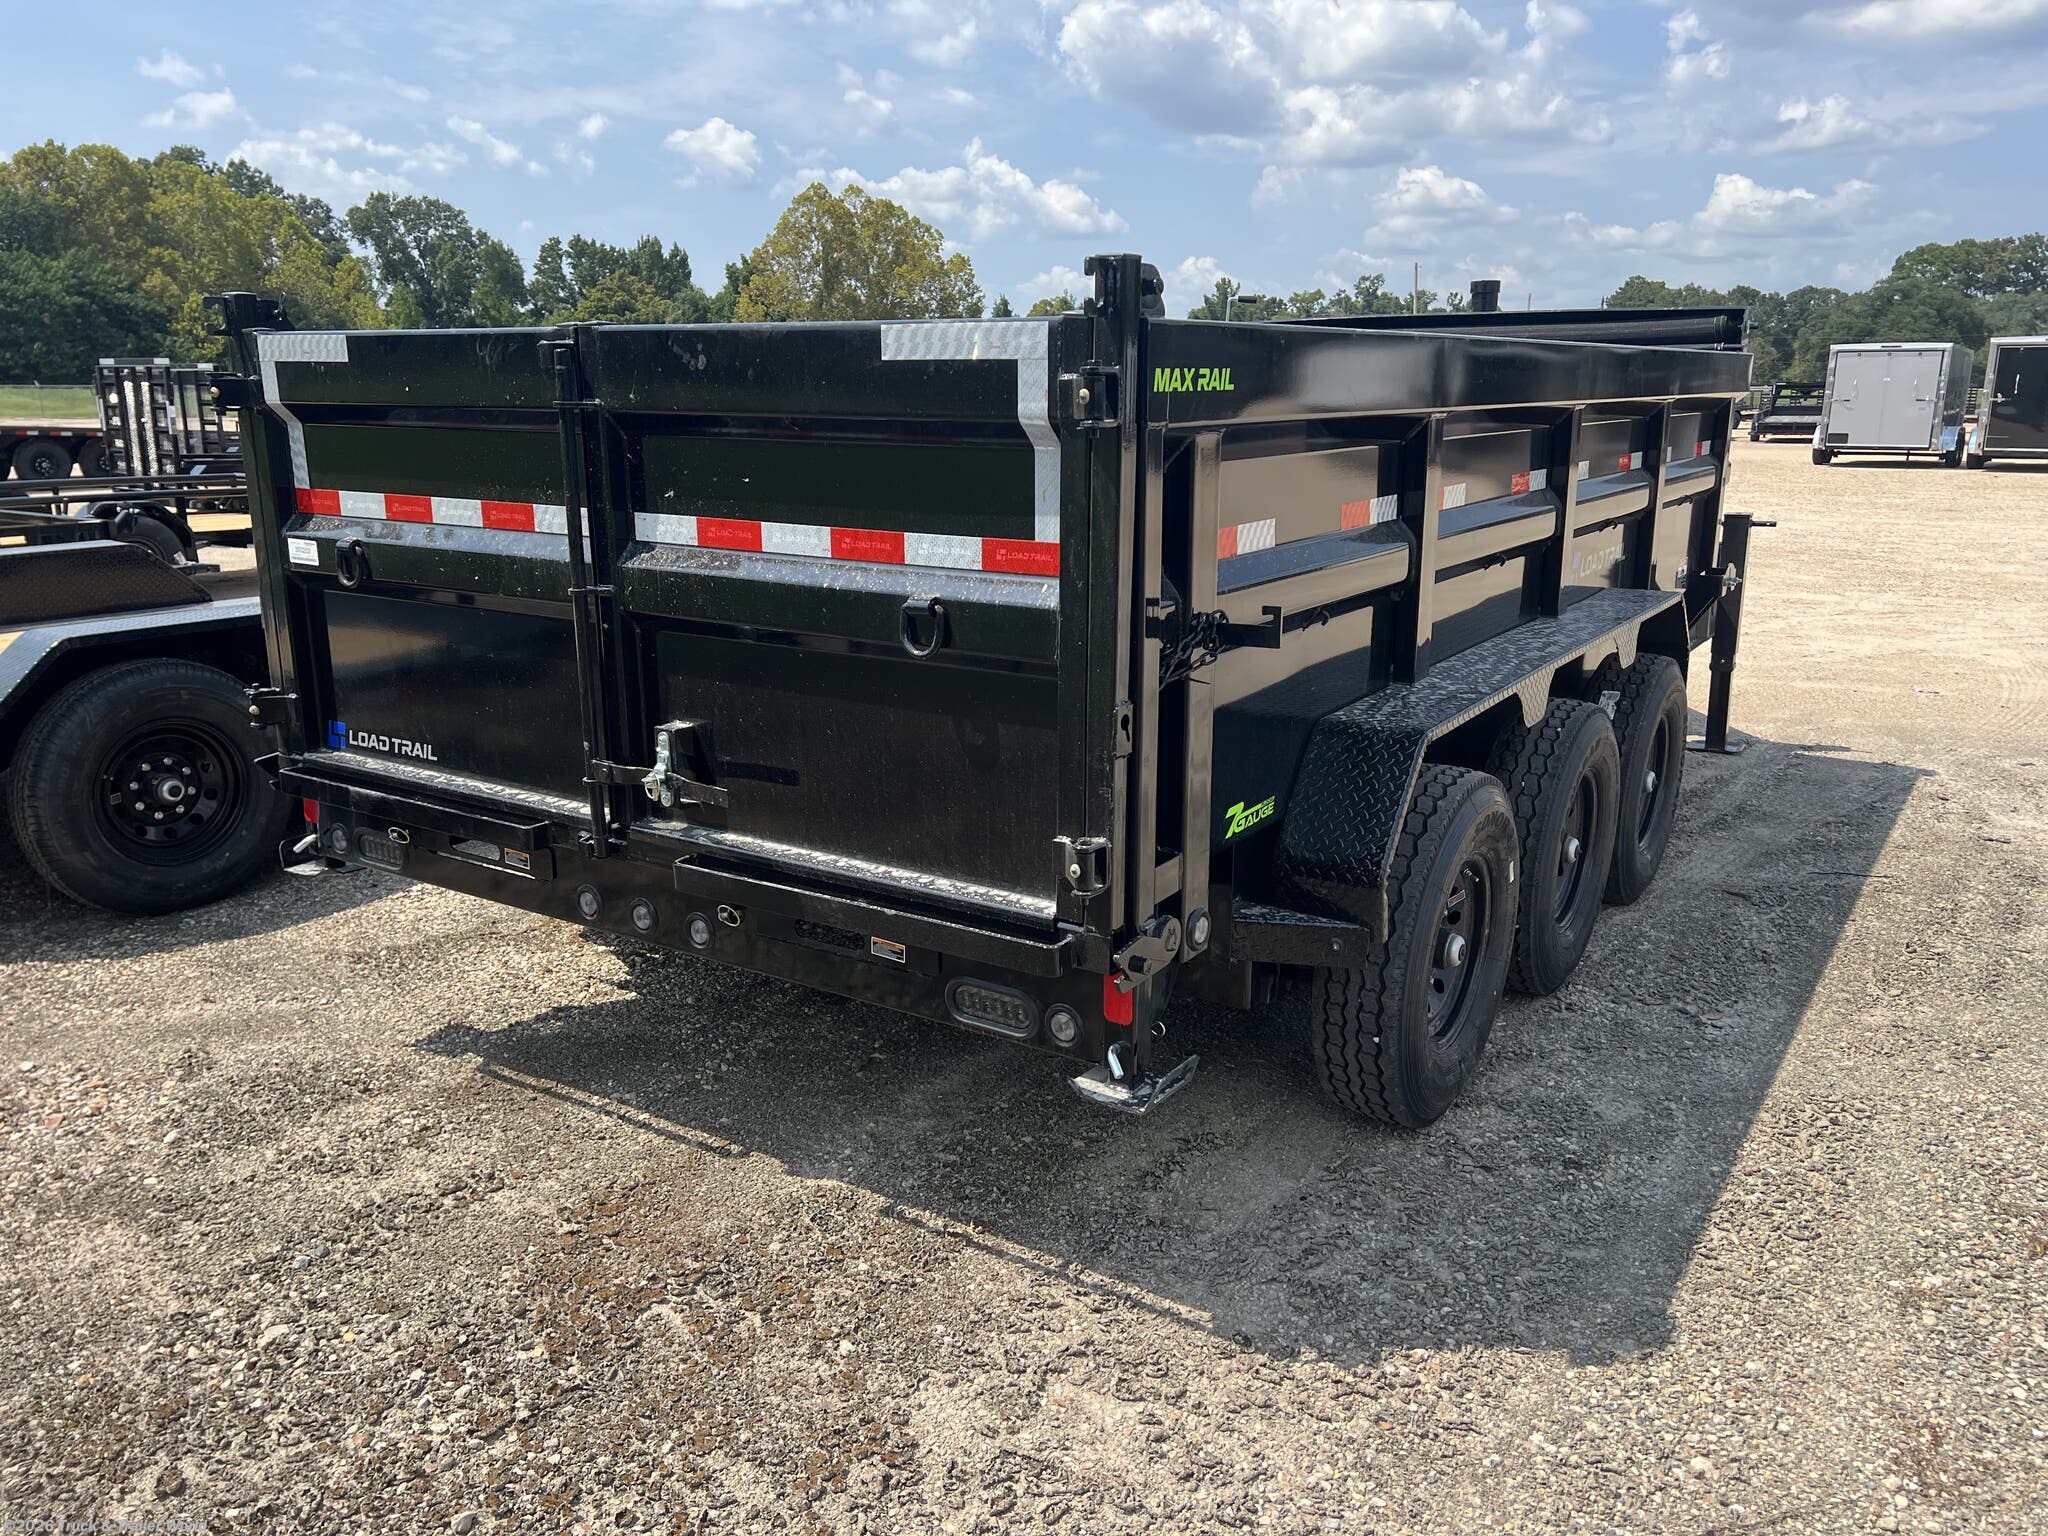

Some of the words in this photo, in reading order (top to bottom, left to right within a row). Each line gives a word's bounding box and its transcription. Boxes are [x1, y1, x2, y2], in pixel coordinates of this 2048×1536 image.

[1153, 368, 1195, 392] MAX
[1197, 368, 1234, 391] RAIL
[1007, 551, 1029, 560] LOAD
[1029, 553, 1053, 562] TRAIL
[349, 730, 389, 751] LOAD
[392, 738, 438, 760] TRAIL
[1225, 801, 1245, 839] 7
[1234, 801, 1275, 832] GAUGE
